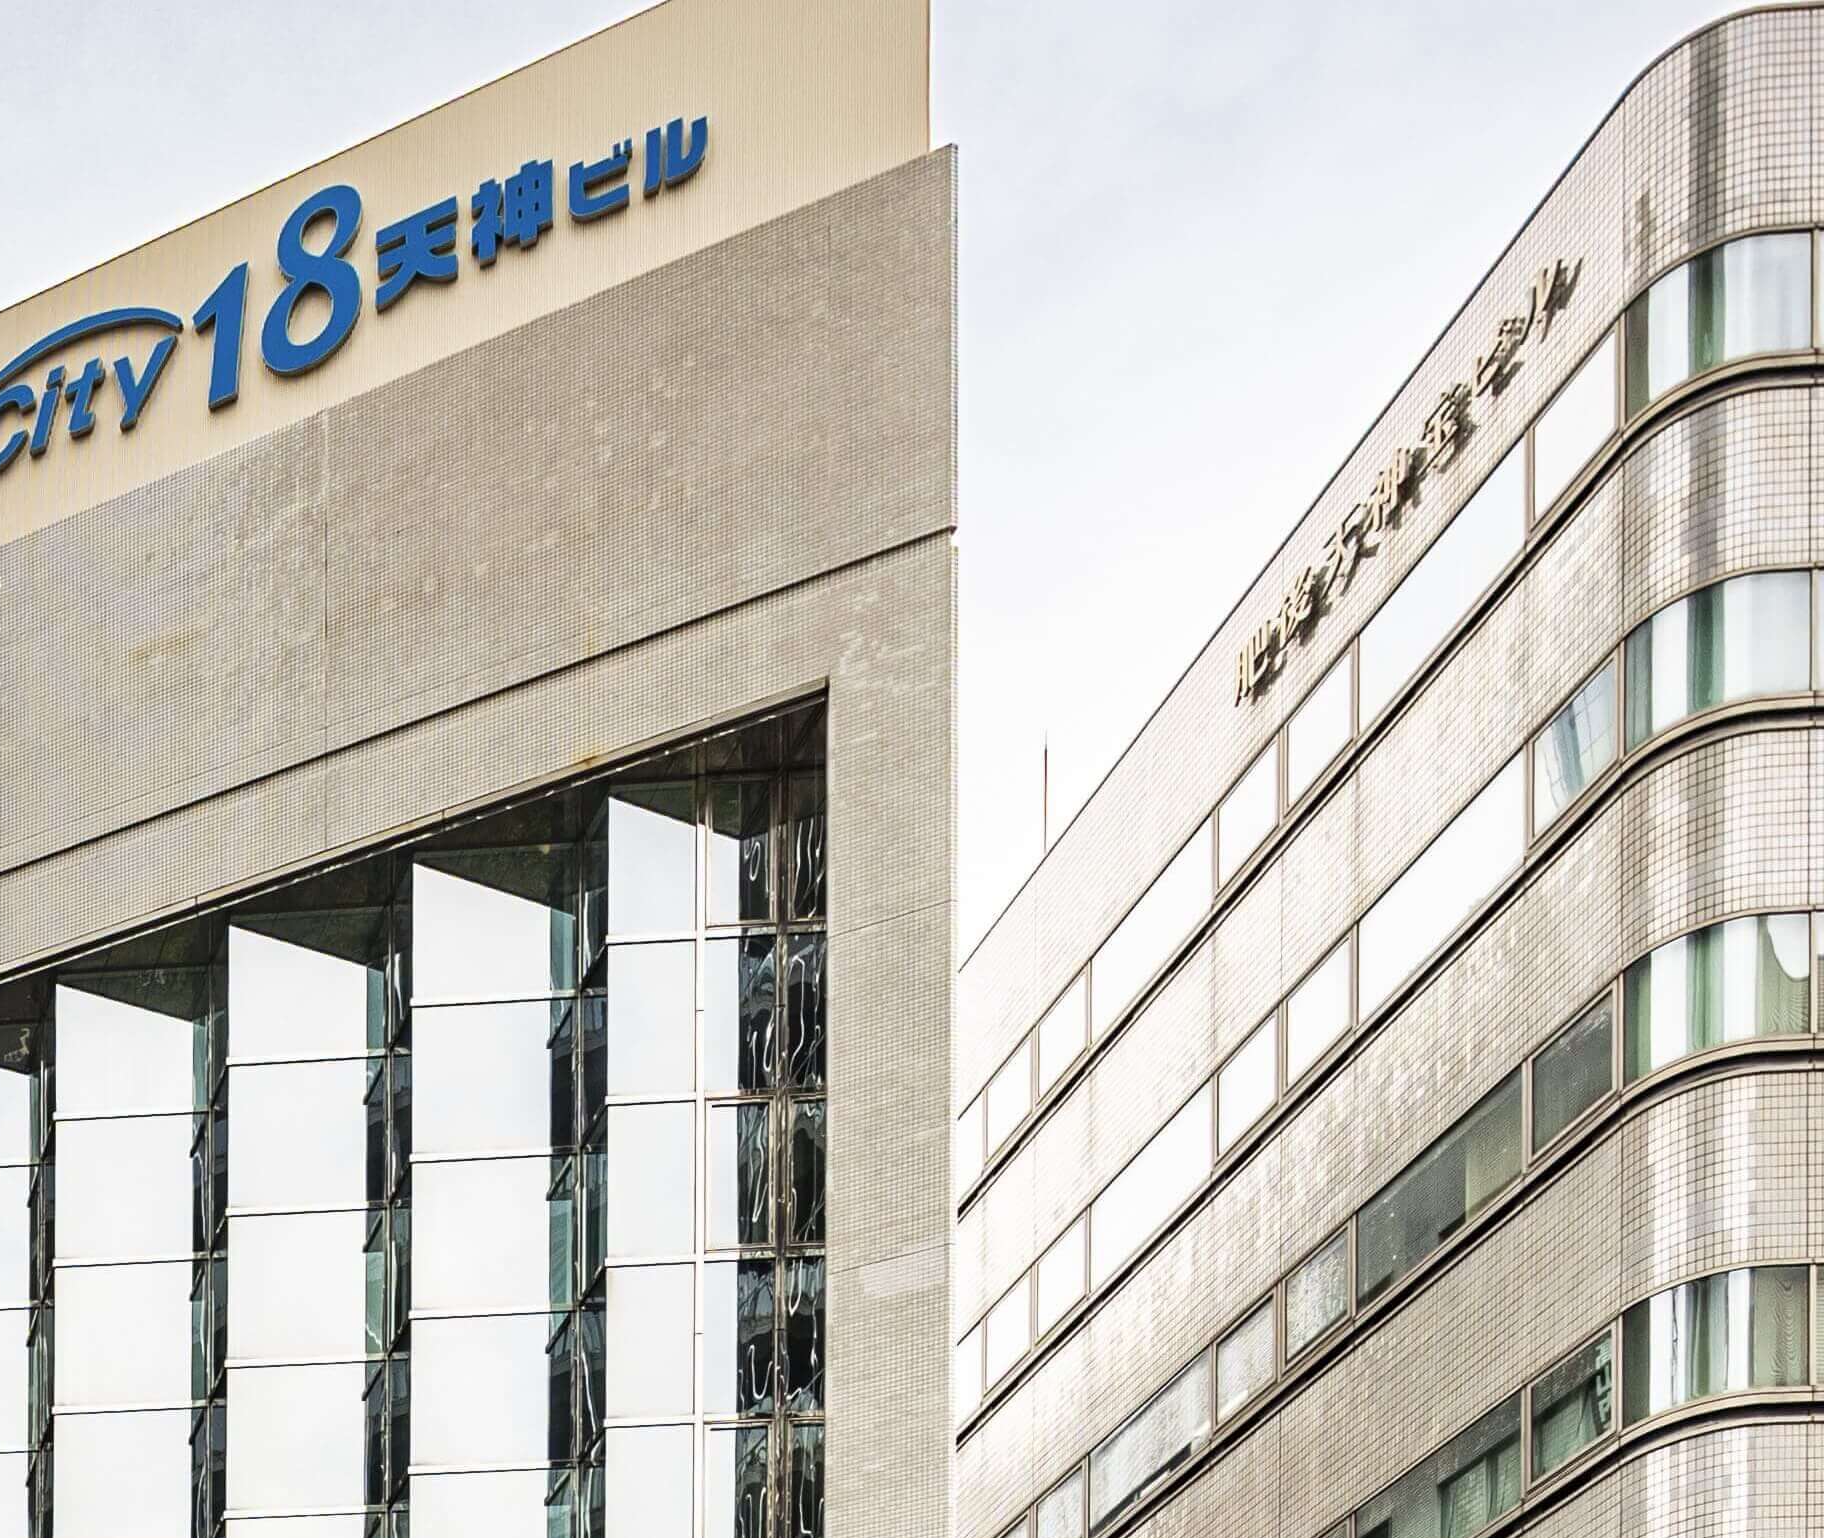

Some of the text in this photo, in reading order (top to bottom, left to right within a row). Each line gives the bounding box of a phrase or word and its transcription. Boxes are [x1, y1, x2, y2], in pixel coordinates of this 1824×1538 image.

[191, 183, 364, 412] 18
[374, 114, 710, 312] 天神ビル
